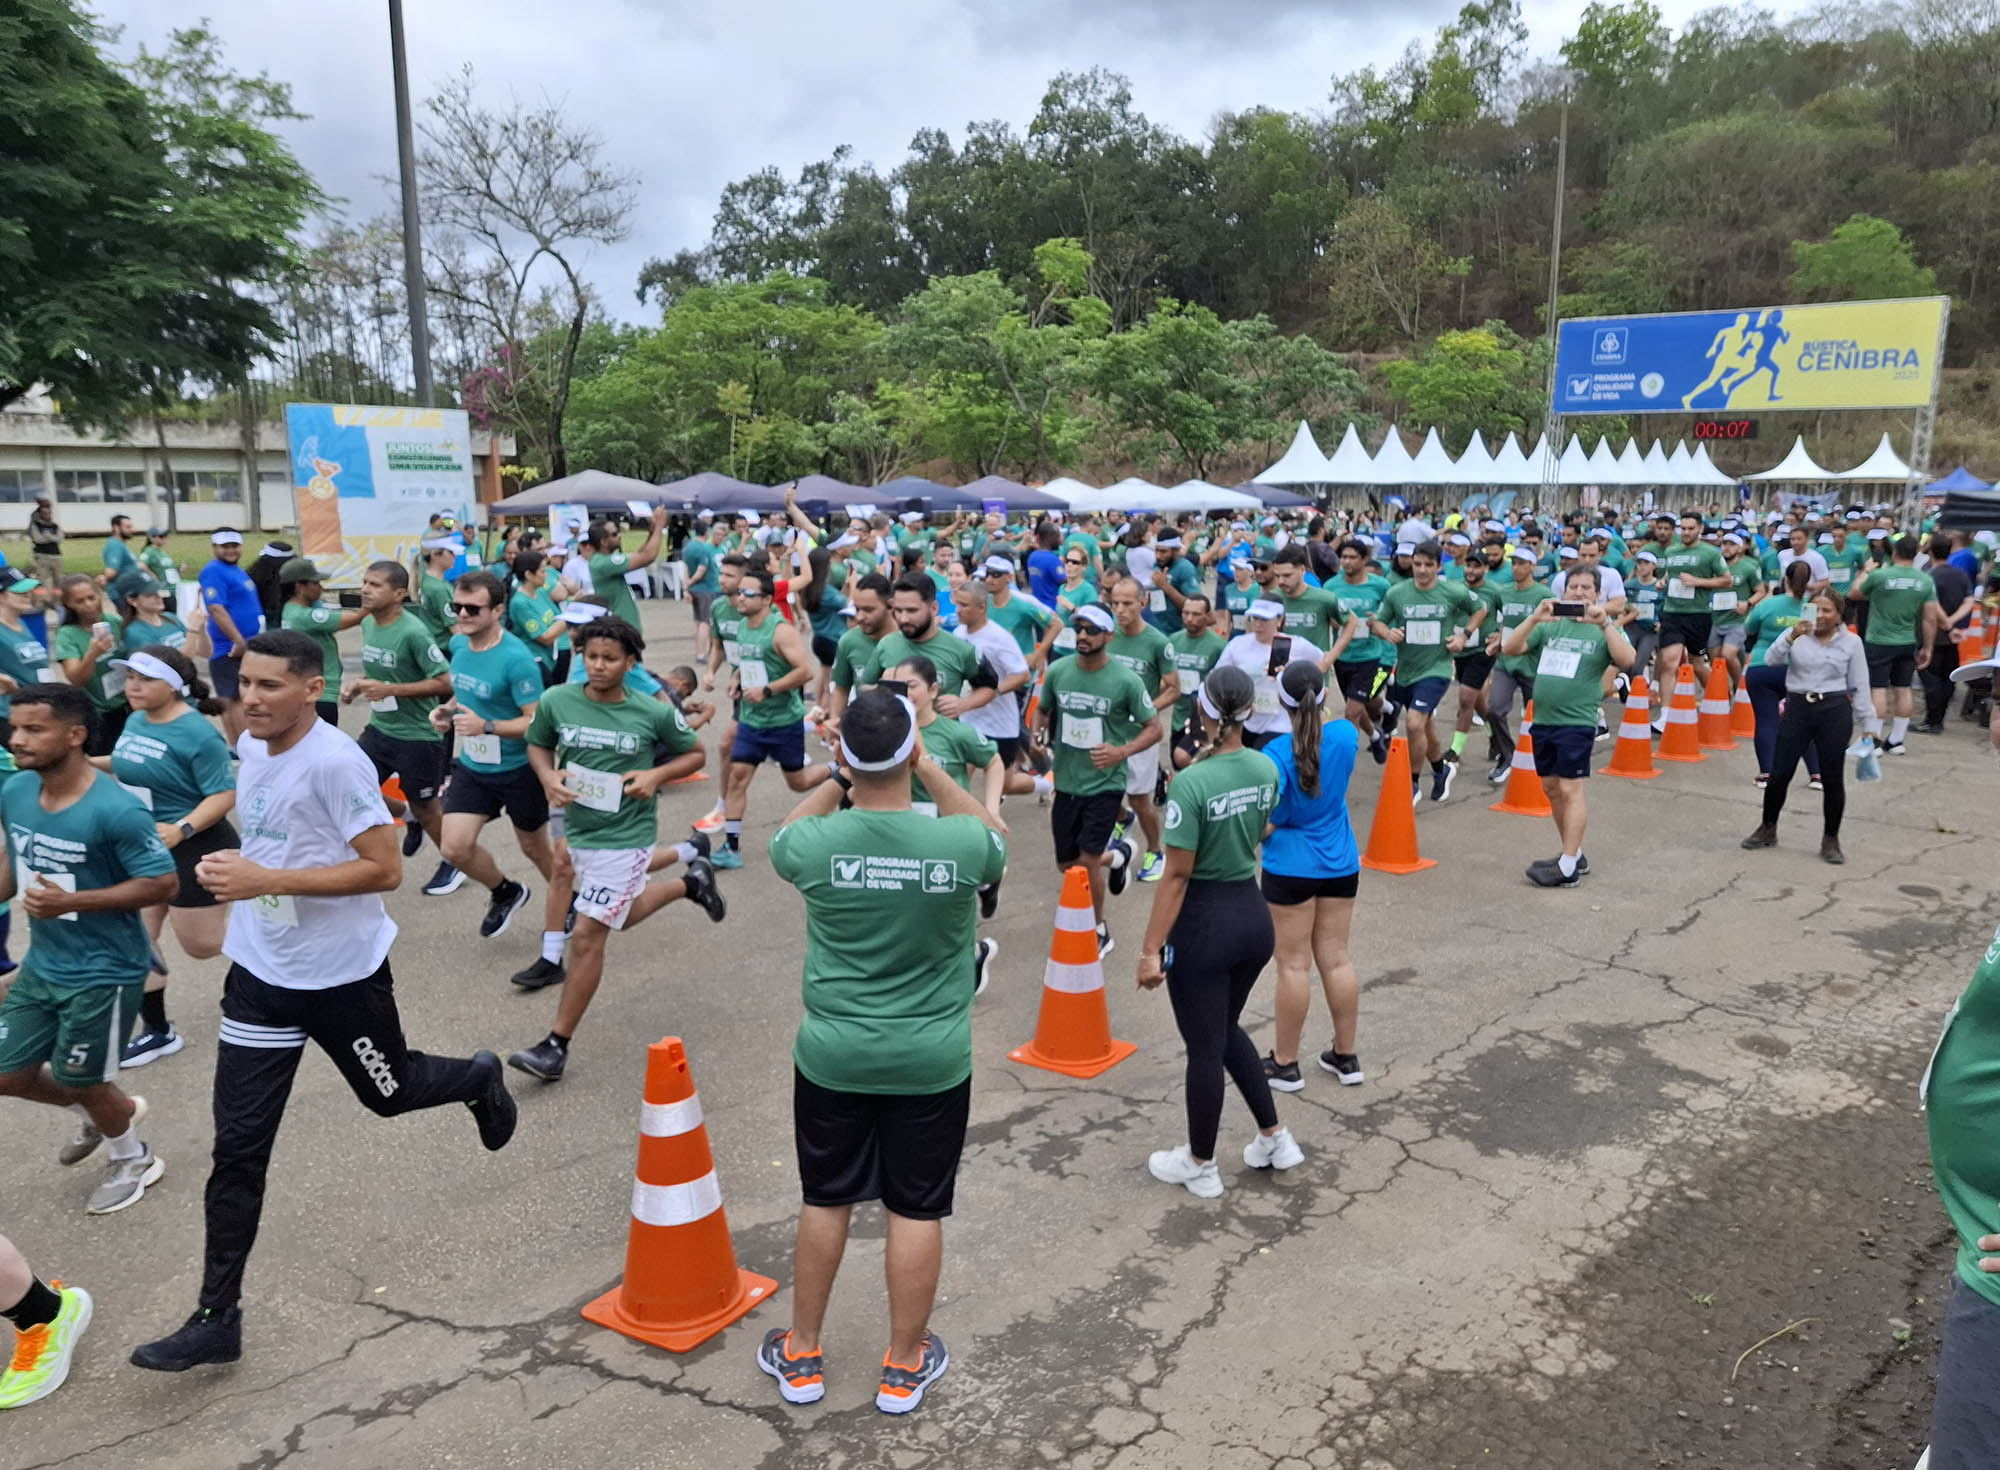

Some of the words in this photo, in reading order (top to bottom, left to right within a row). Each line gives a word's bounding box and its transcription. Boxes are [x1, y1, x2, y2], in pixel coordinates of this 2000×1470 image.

[1797, 348, 1919, 372] CENIBRA
[1695, 421, 1750, 438] 00:07
[866, 856, 921, 870] PROGRAMA
[866, 867, 920, 881] QUALIDADE
[866, 879, 880, 889] DE
[880, 880, 903, 890] VIDA
[67, 1042, 90, 1065] 5
[352, 1036, 399, 1098] adidas
